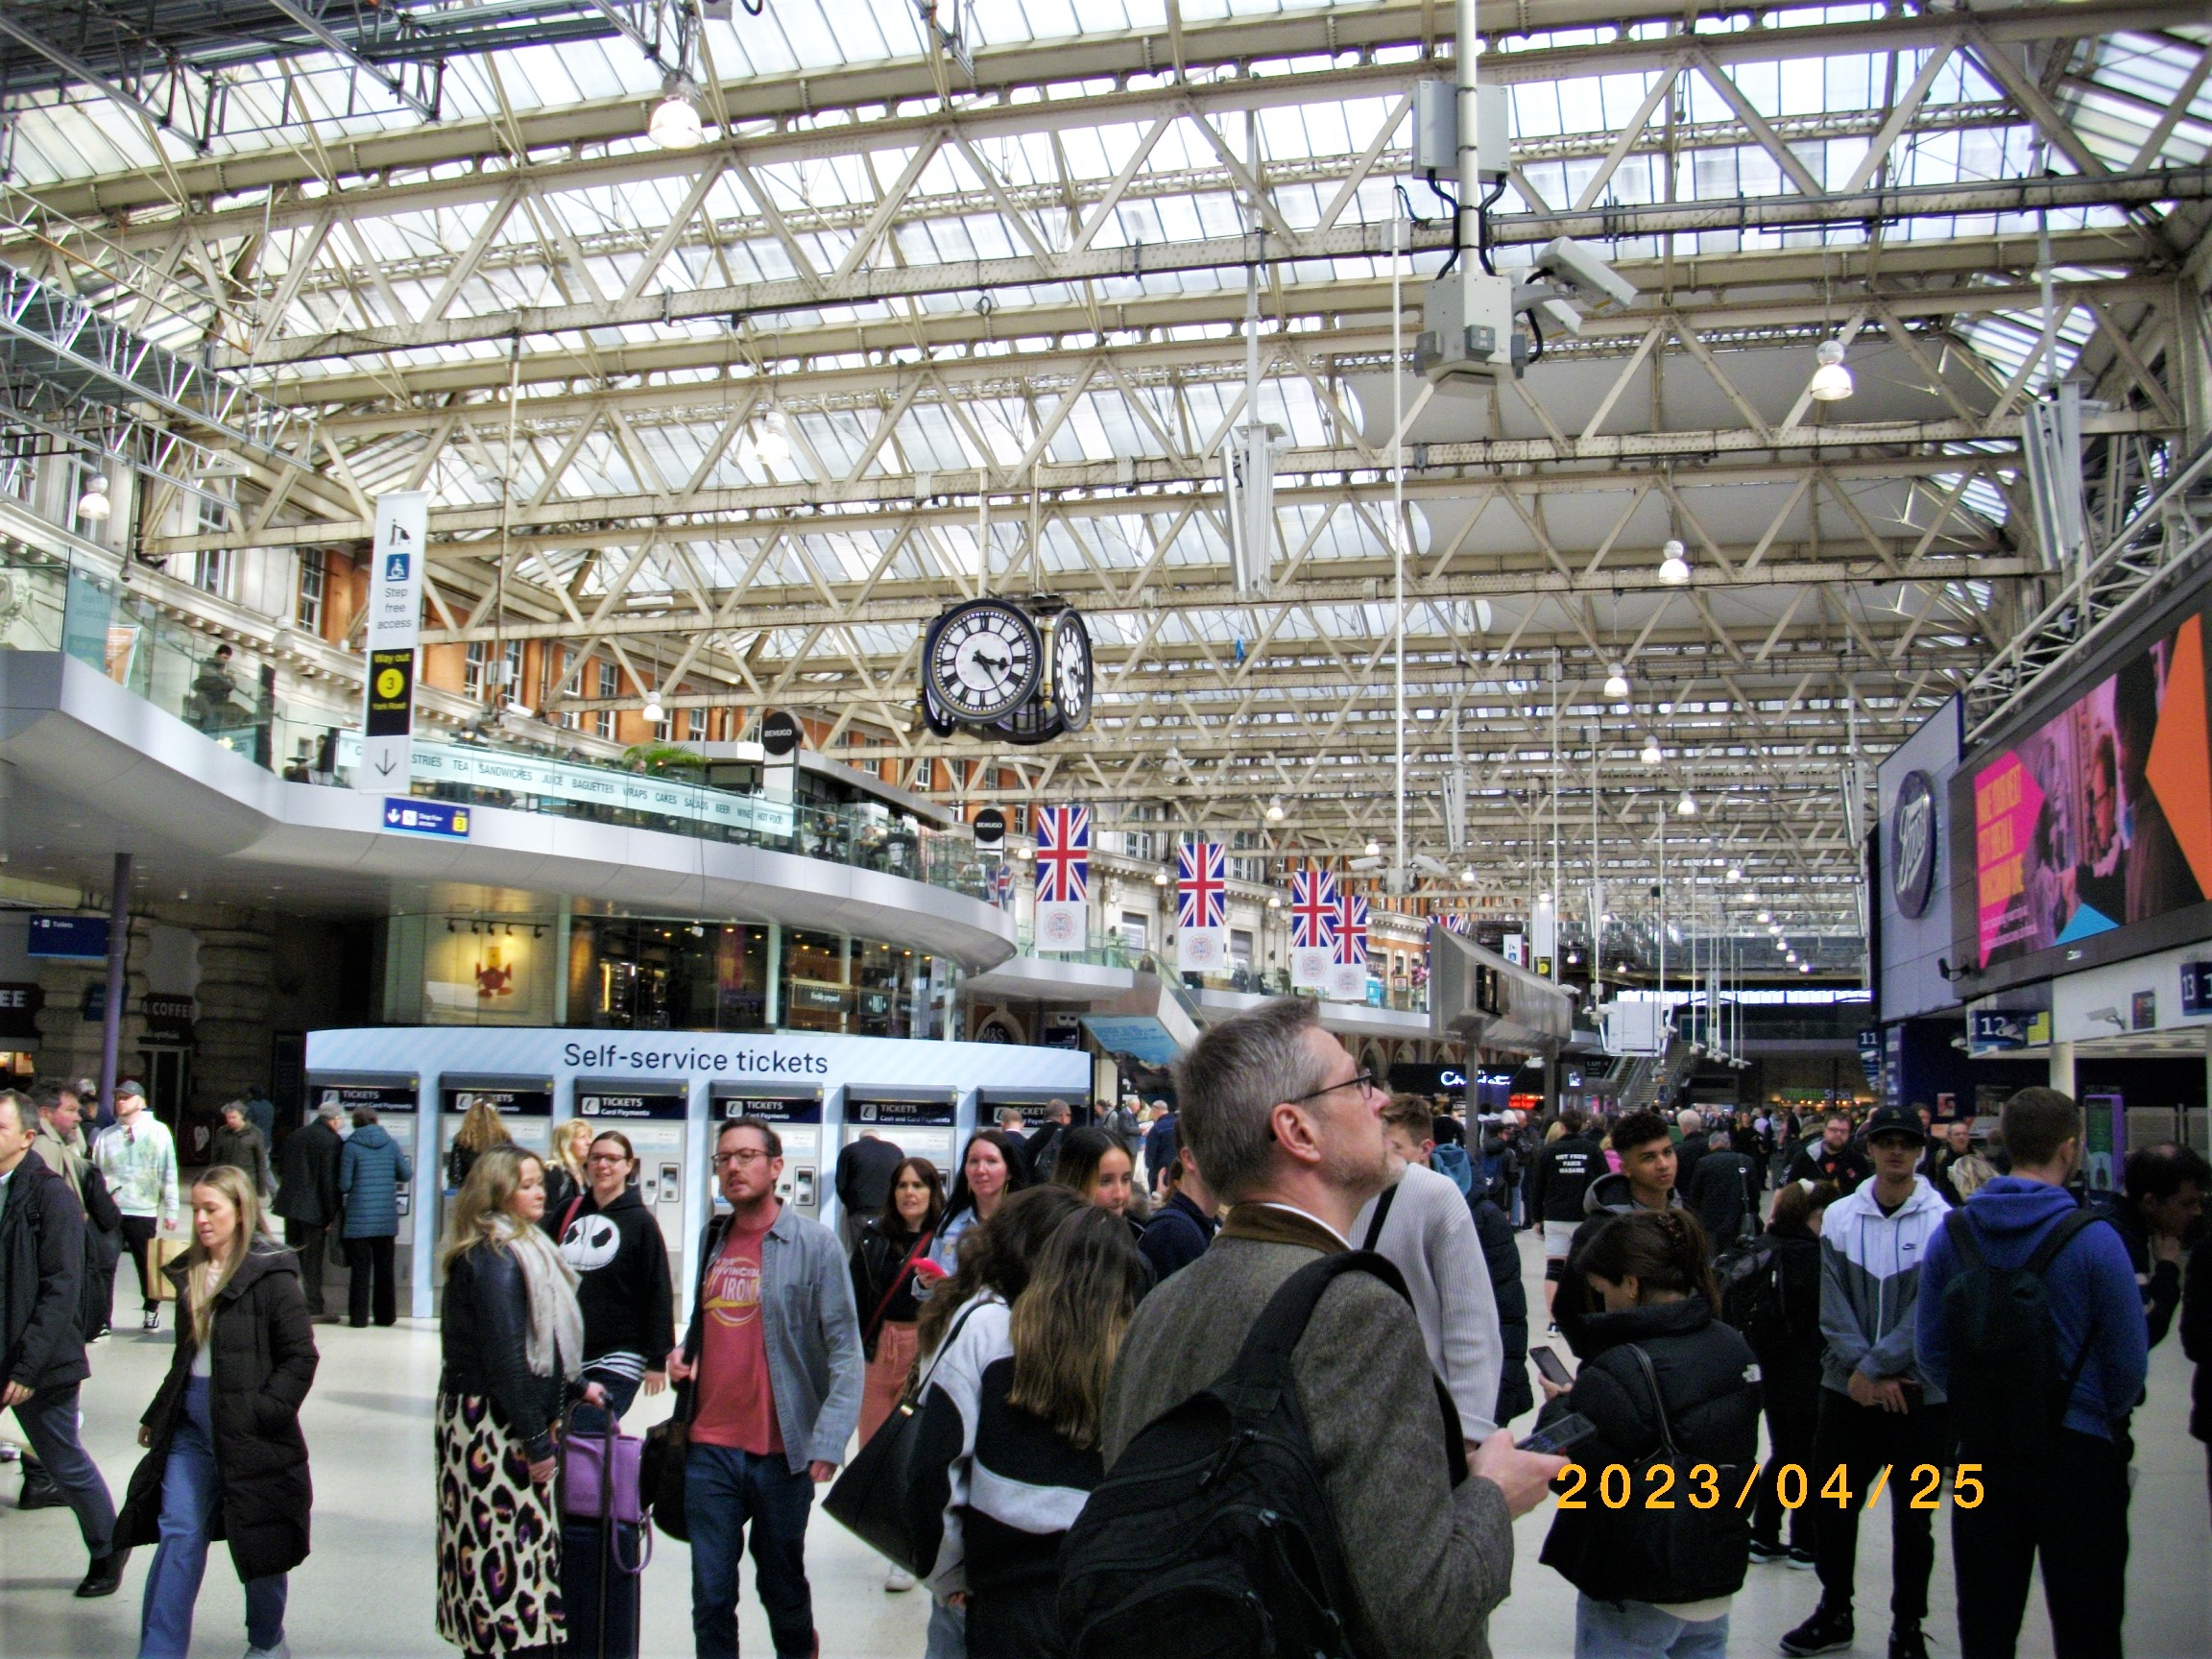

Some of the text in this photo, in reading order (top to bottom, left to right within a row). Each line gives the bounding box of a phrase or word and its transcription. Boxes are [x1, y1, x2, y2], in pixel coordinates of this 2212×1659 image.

[384, 588, 408, 599] Step
[384, 603, 405, 613] free
[377, 619, 412, 630] access
[374, 653, 411, 664] Way out
[386, 677, 395, 690] 3
[764, 729, 792, 737] BENUGO
[411, 754, 783, 826] STRIES TEA SANDWICHES JUICE BAGUETTES WRAPS CAKES SALADS BEER WINE HOT FOOD
[982, 1027, 1004, 1040] M&S
[1861, 1032, 1878, 1045] 11
[564, 1043, 828, 1073] Self-service tickets
[343, 1090, 380, 1100] TICKETS
[602, 1097, 643, 1108] TICKETS
[747, 1101, 783, 1111] TICKETS
[601, 1108, 650, 1118] Card Payments
[880, 1105, 917, 1114] TICKETS
